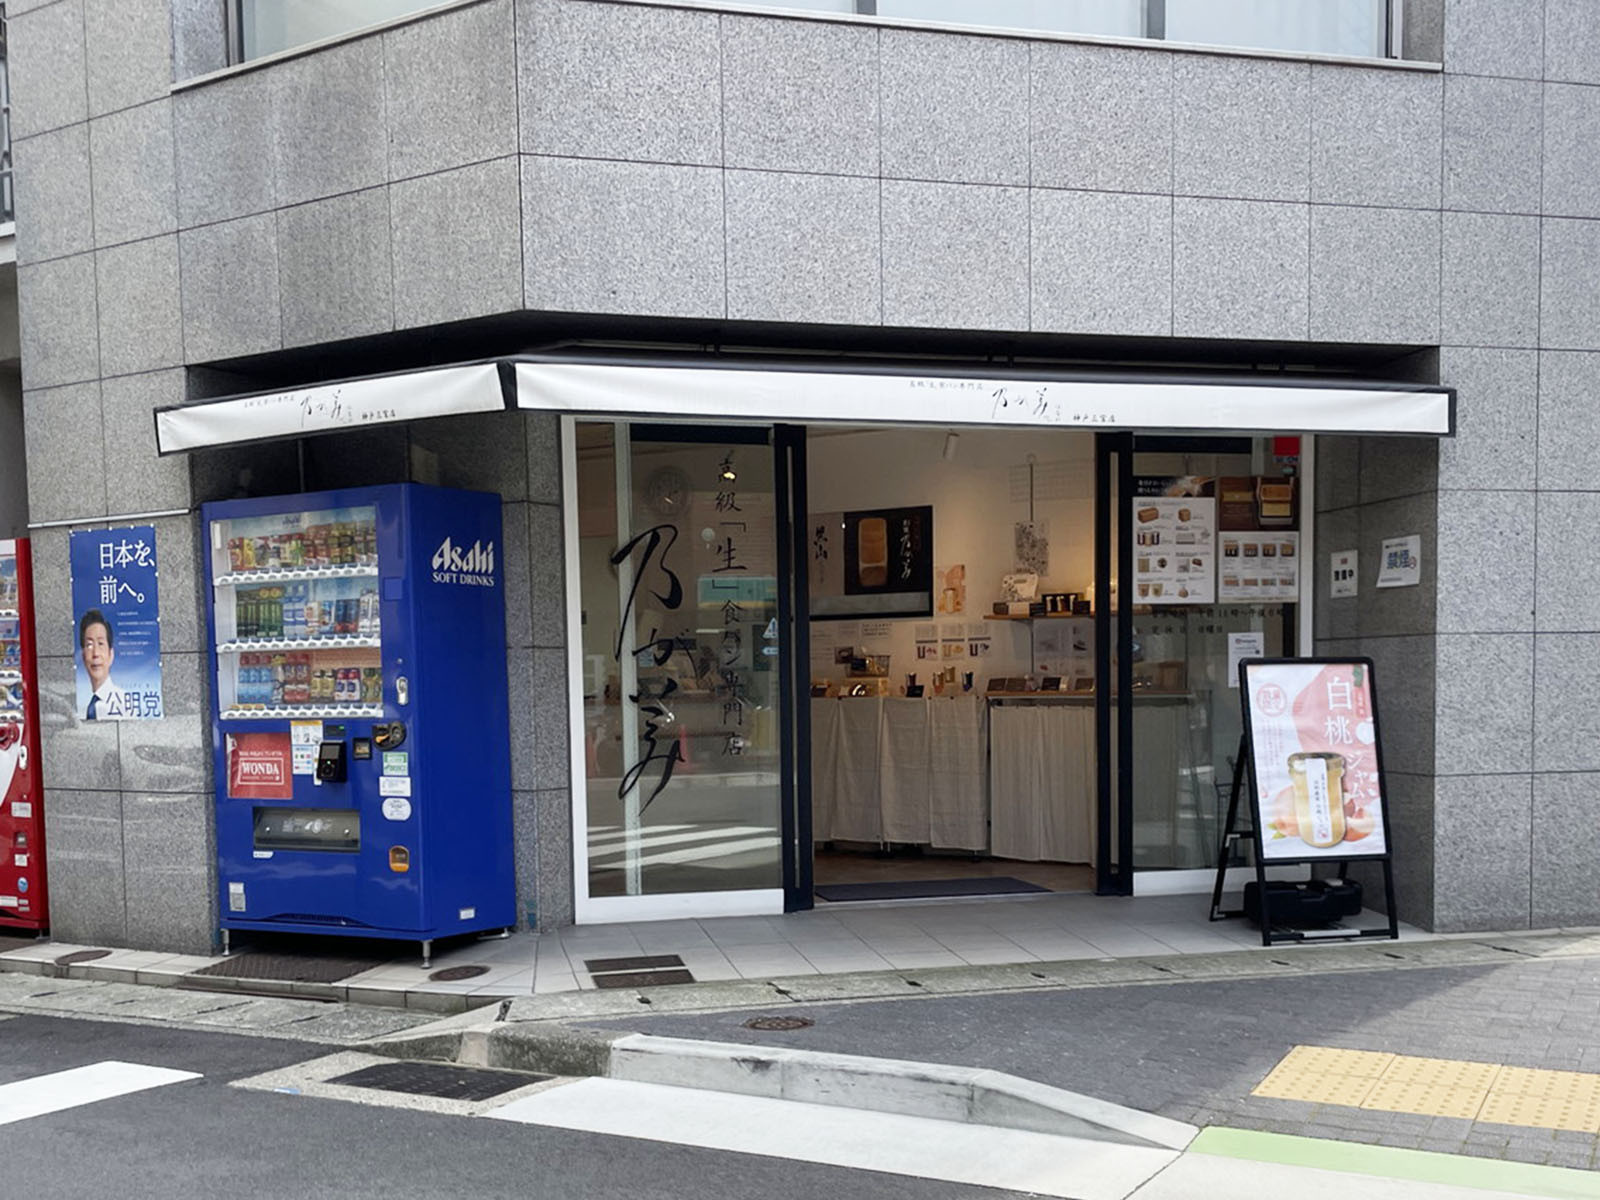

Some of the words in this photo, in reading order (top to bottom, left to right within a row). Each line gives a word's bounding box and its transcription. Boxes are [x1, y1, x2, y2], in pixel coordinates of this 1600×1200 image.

[99, 540, 155, 569] 日本を、
[432, 536, 494, 574] Asahi
[98, 575, 145, 604] 前へ。
[432, 571, 458, 584] SOFT
[460, 574, 495, 587] DRINKS
[106, 690, 162, 718] 公明党
[1324, 676, 1353, 745] 白桃
[241, 761, 280, 776] WONDA
